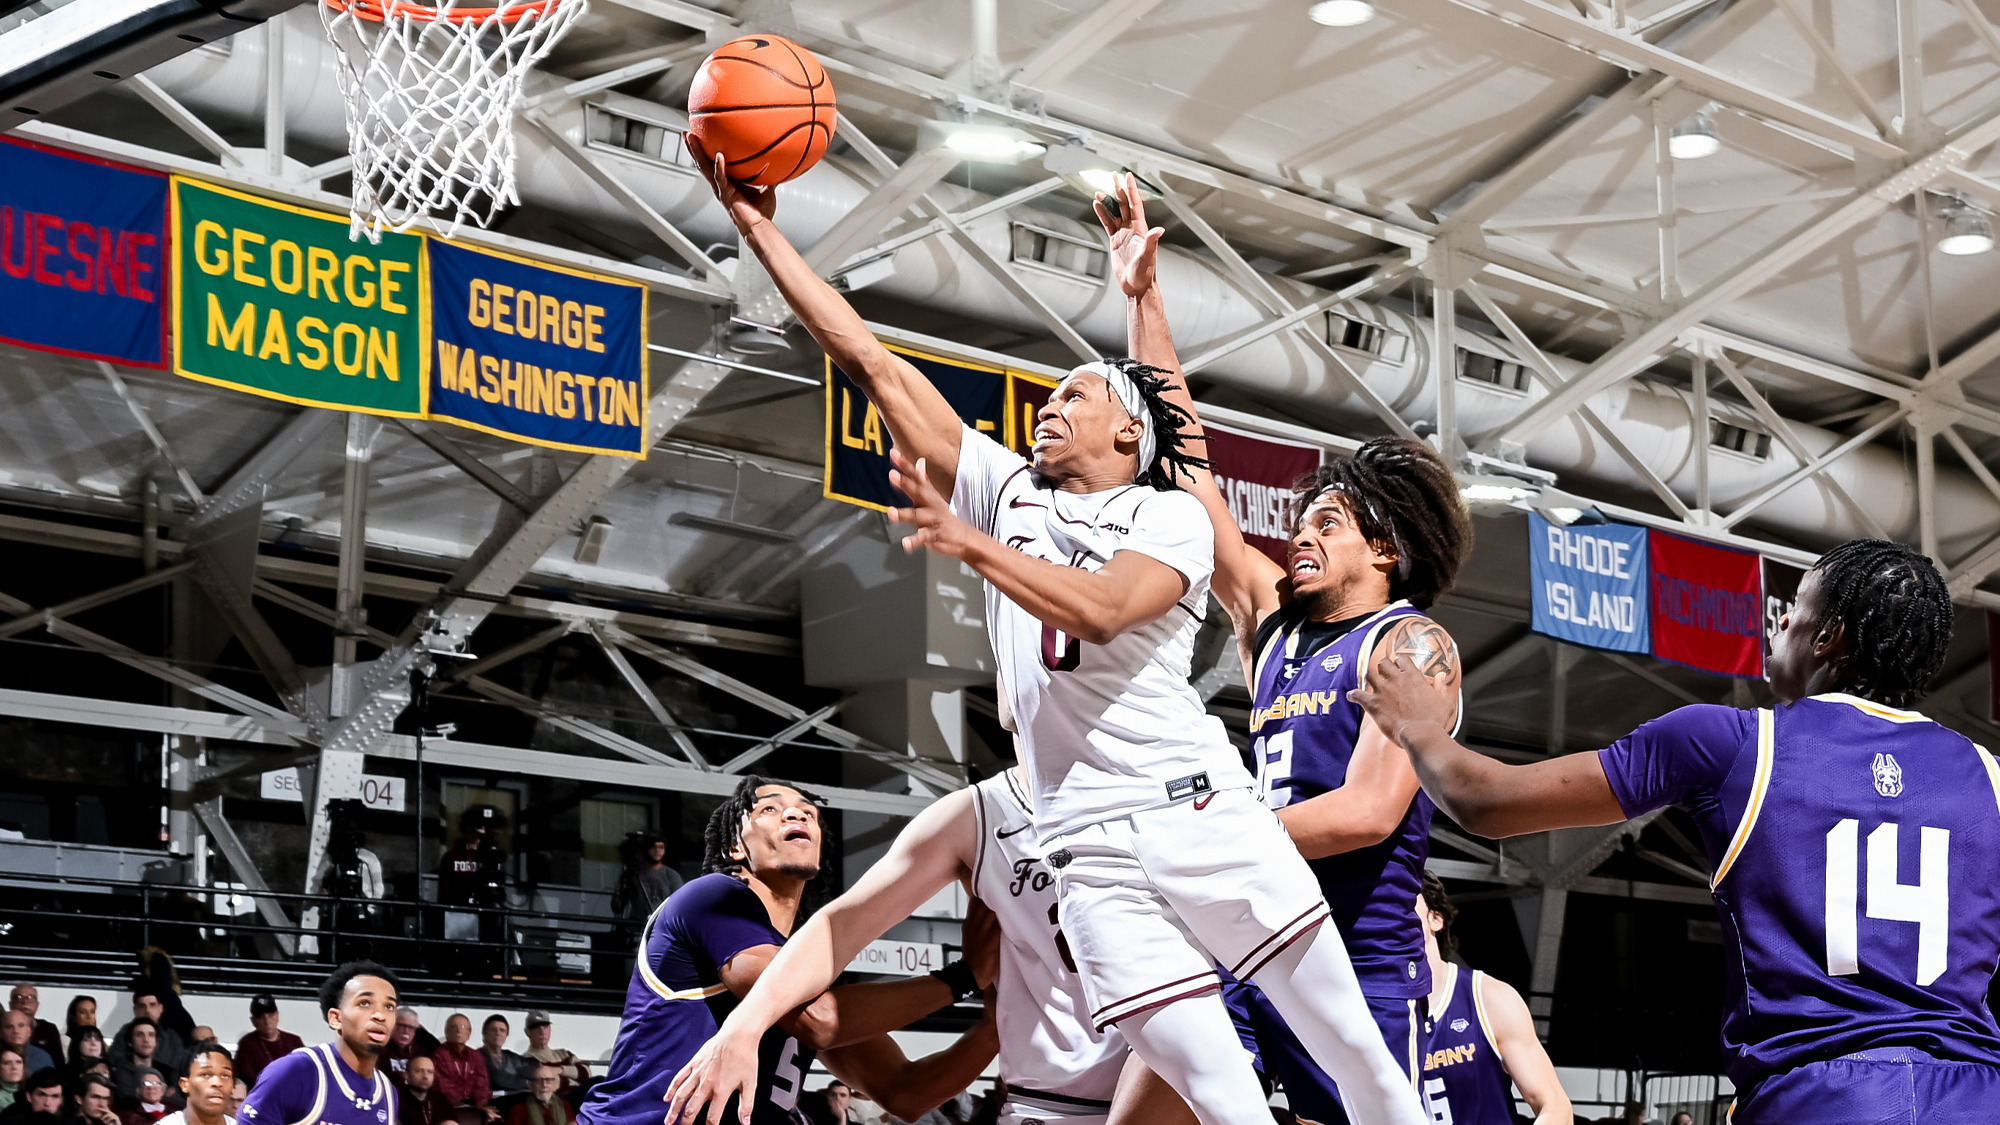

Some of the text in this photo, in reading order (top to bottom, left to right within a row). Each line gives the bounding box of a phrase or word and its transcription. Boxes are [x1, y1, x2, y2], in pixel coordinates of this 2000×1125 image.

[0, 205, 156, 303] UESNE
[194, 219, 411, 315] GEORGE
[206, 292, 400, 381] MASON
[468, 278, 606, 354] GEORGE
[437, 339, 640, 427] WASHINGTON
[1547, 525, 1631, 580] RHODE
[1545, 578, 1635, 634] ISLAND
[1656, 572, 1759, 637] RICHMOND
[359, 778, 394, 807] 04
[1254, 729, 1295, 810] 12
[1825, 818, 1951, 987] 14
[895, 945, 933, 972] 104
